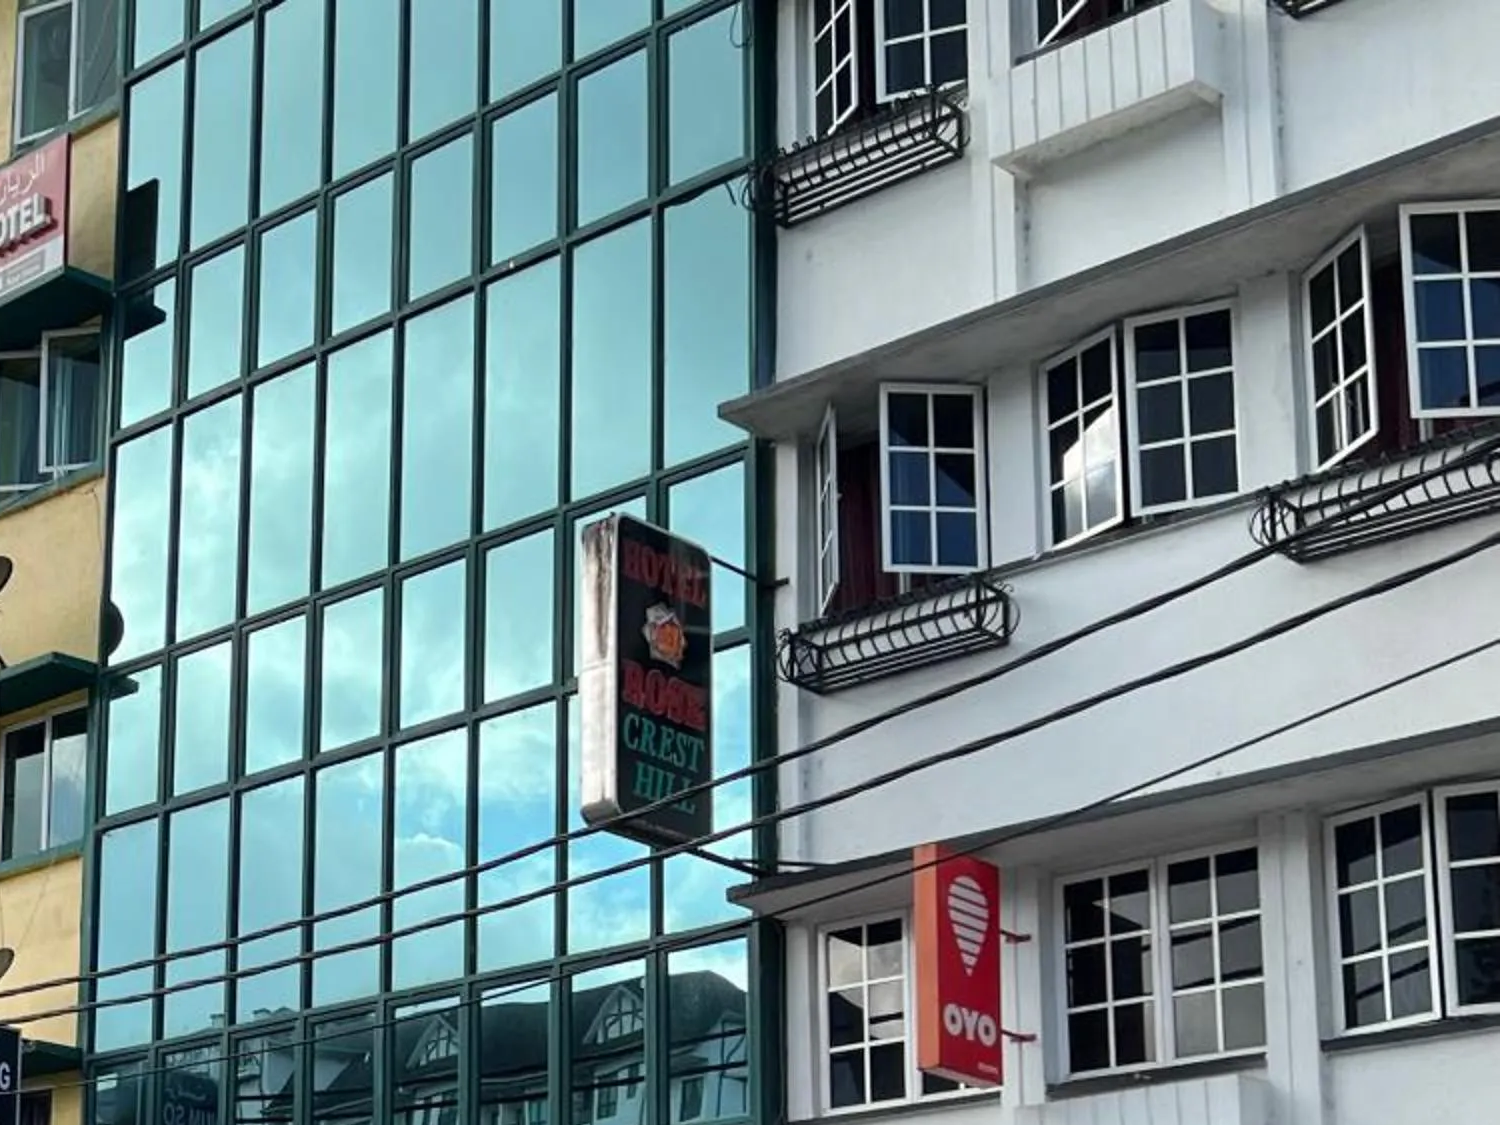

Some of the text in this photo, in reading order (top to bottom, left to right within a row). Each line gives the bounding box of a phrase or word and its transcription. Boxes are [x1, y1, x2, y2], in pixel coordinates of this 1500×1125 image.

[622, 540, 708, 608] HOTEL
[623, 714, 706, 773] CREST
[633, 760, 697, 815] HILL
[943, 1003, 997, 1046] OYO
